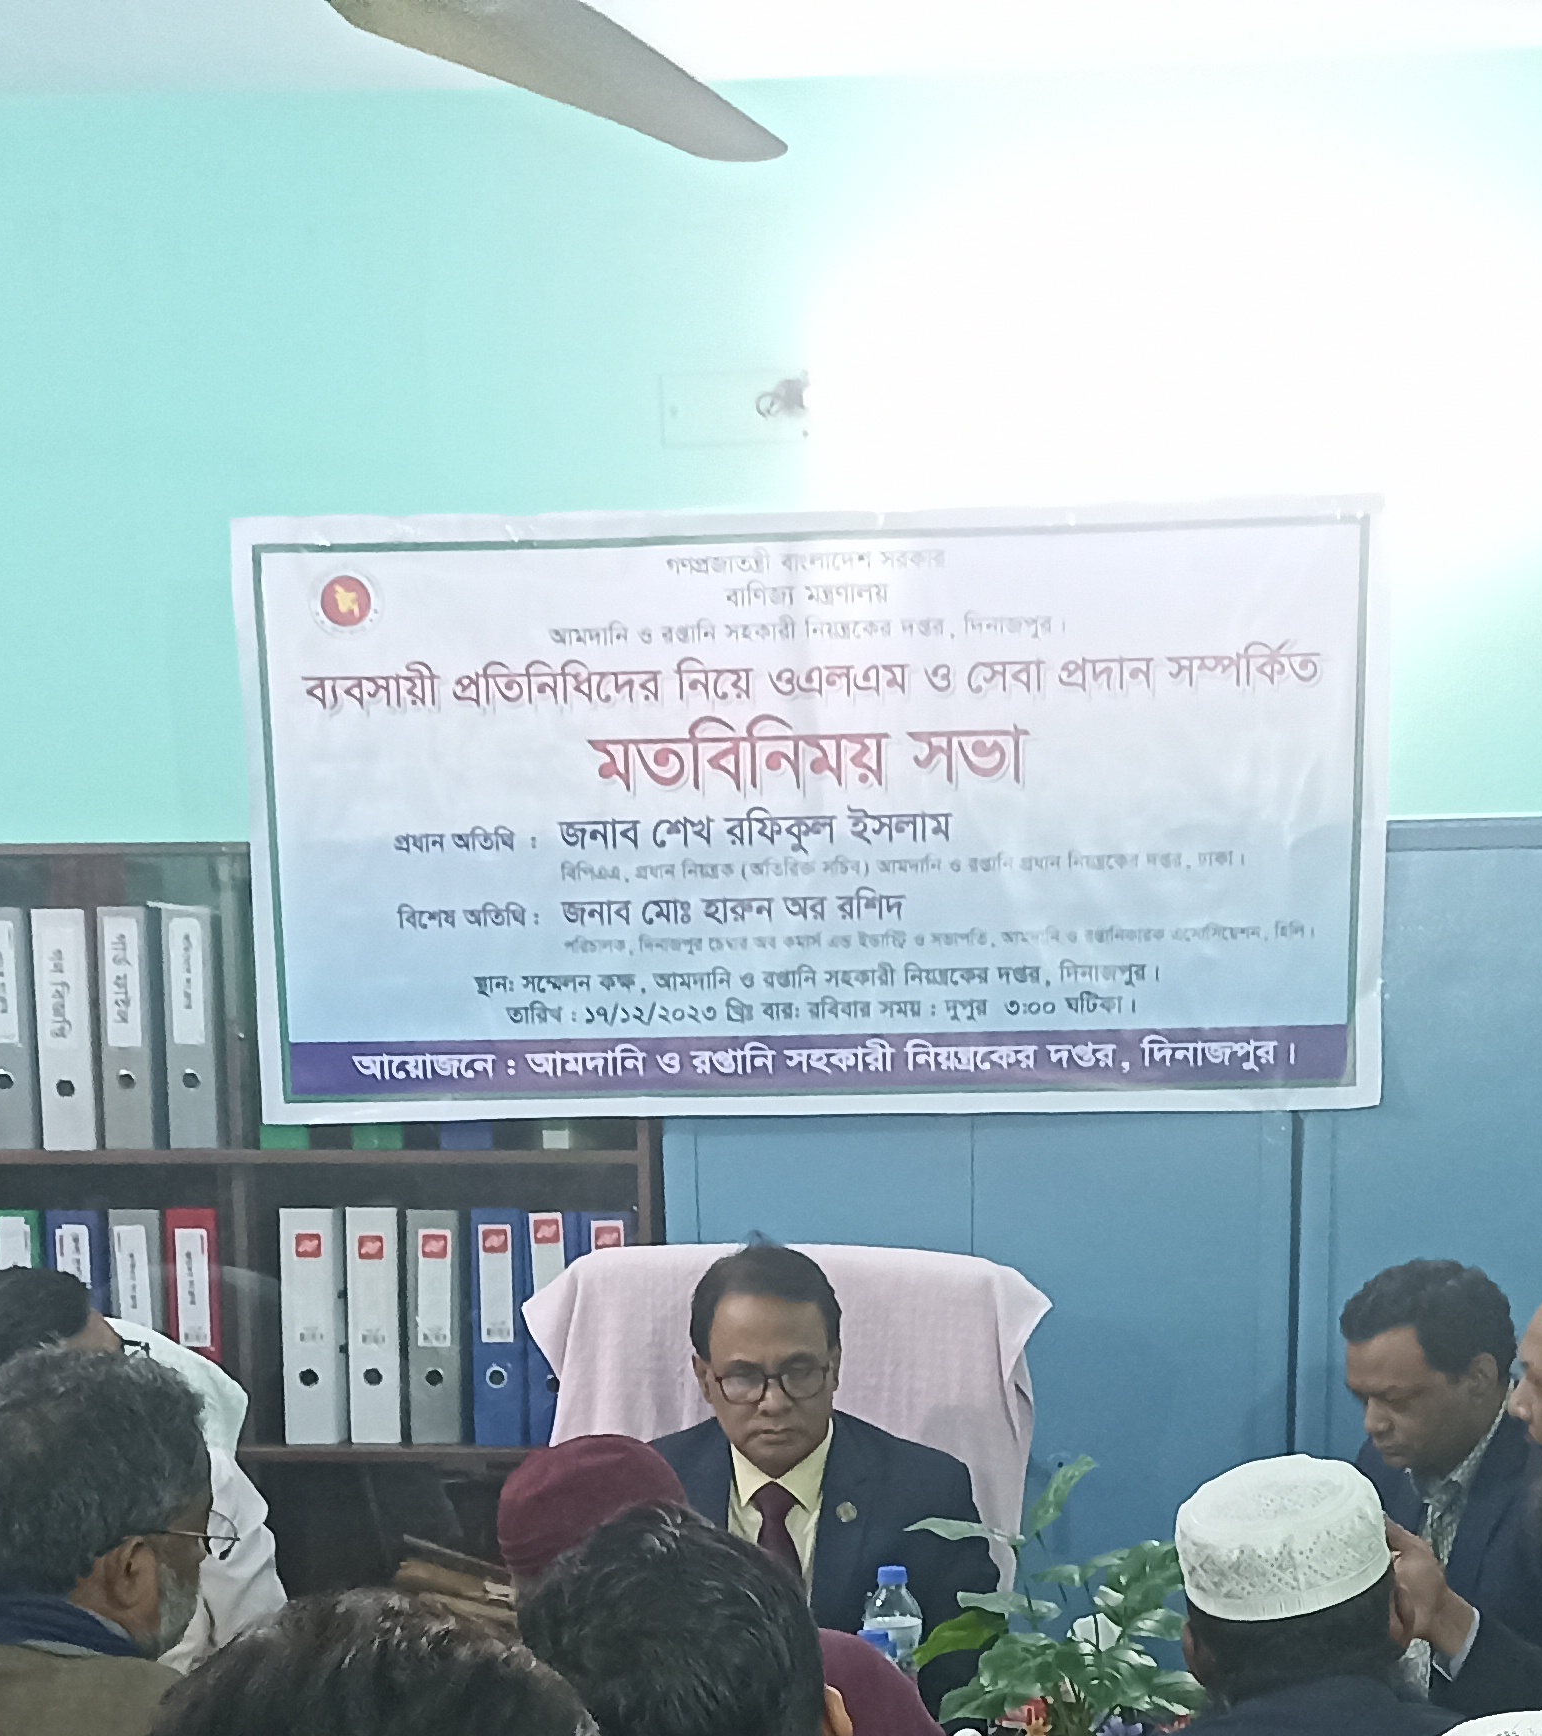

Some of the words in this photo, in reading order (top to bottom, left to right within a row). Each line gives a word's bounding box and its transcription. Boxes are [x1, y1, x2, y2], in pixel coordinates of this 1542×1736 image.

[781, 551, 871, 573] বাংলাদেশ
[548, 619, 628, 647] আমদানি
[636, 626, 653, 645] ও
[302, 660, 442, 710] ব্যবসায়ী
[452, 658, 663, 708] প্রতিনিধিদের
[673, 655, 754, 704] নিয়ে
[767, 662, 912, 698] ওএলএম
[923, 661, 952, 697] ও
[966, 657, 1046, 695] সেবা
[1057, 655, 1154, 693] প্রদান
[1165, 639, 1321, 689] সম্পর্কিত
[586, 714, 891, 792] মতবিনিময়
[907, 722, 1030, 786] সভা
[394, 831, 444, 854] প্রধান
[450, 826, 515, 854] অতিথি
[558, 818, 640, 851] জনাব
[651, 815, 715, 848] শেখ
[723, 806, 838, 854] রফিকুল
[846, 804, 953, 844] ইসলাম
[949, 858, 961, 873] ও
[396, 902, 456, 929] বিশেষ
[463, 900, 526, 928] অতিথি
[560, 899, 632, 928] জনাব
[641, 898, 692, 927] মোঃ
[701, 896, 774, 927] হারুন
[782, 895, 827, 923] অর
[835, 885, 906, 922] রশিদ
[521, 974, 592, 994] সম্মেলন
[652, 965, 732, 991] আমদানি
[739, 971, 755, 989] ও
[761, 963, 817, 990] রপ্তানি
[824, 961, 896, 988] সহকারী
[1058, 958, 1147, 987] দিনাজপুর
[506, 1000, 563, 1025] তারিখ
[584, 1001, 718, 1027] ১৭/১২/২০২৩
[807, 995, 871, 1020] রবিবার
[877, 999, 922, 1019] সময়
[944, 998, 988, 1022] দুপুর
[1064, 990, 1123, 1015] ঘটিকা
[352, 1050, 496, 1081] আয়োজনে
[525, 1042, 647, 1079] আমদানি
[655, 1050, 681, 1075] ও
[689, 1040, 776, 1077] রপ্তানি
[783, 1037, 896, 1074] সহকারী
[905, 1037, 1036, 1073] নিয়ন্ত্রকের
[1140, 1033, 1279, 1071] দিনাজপুর
